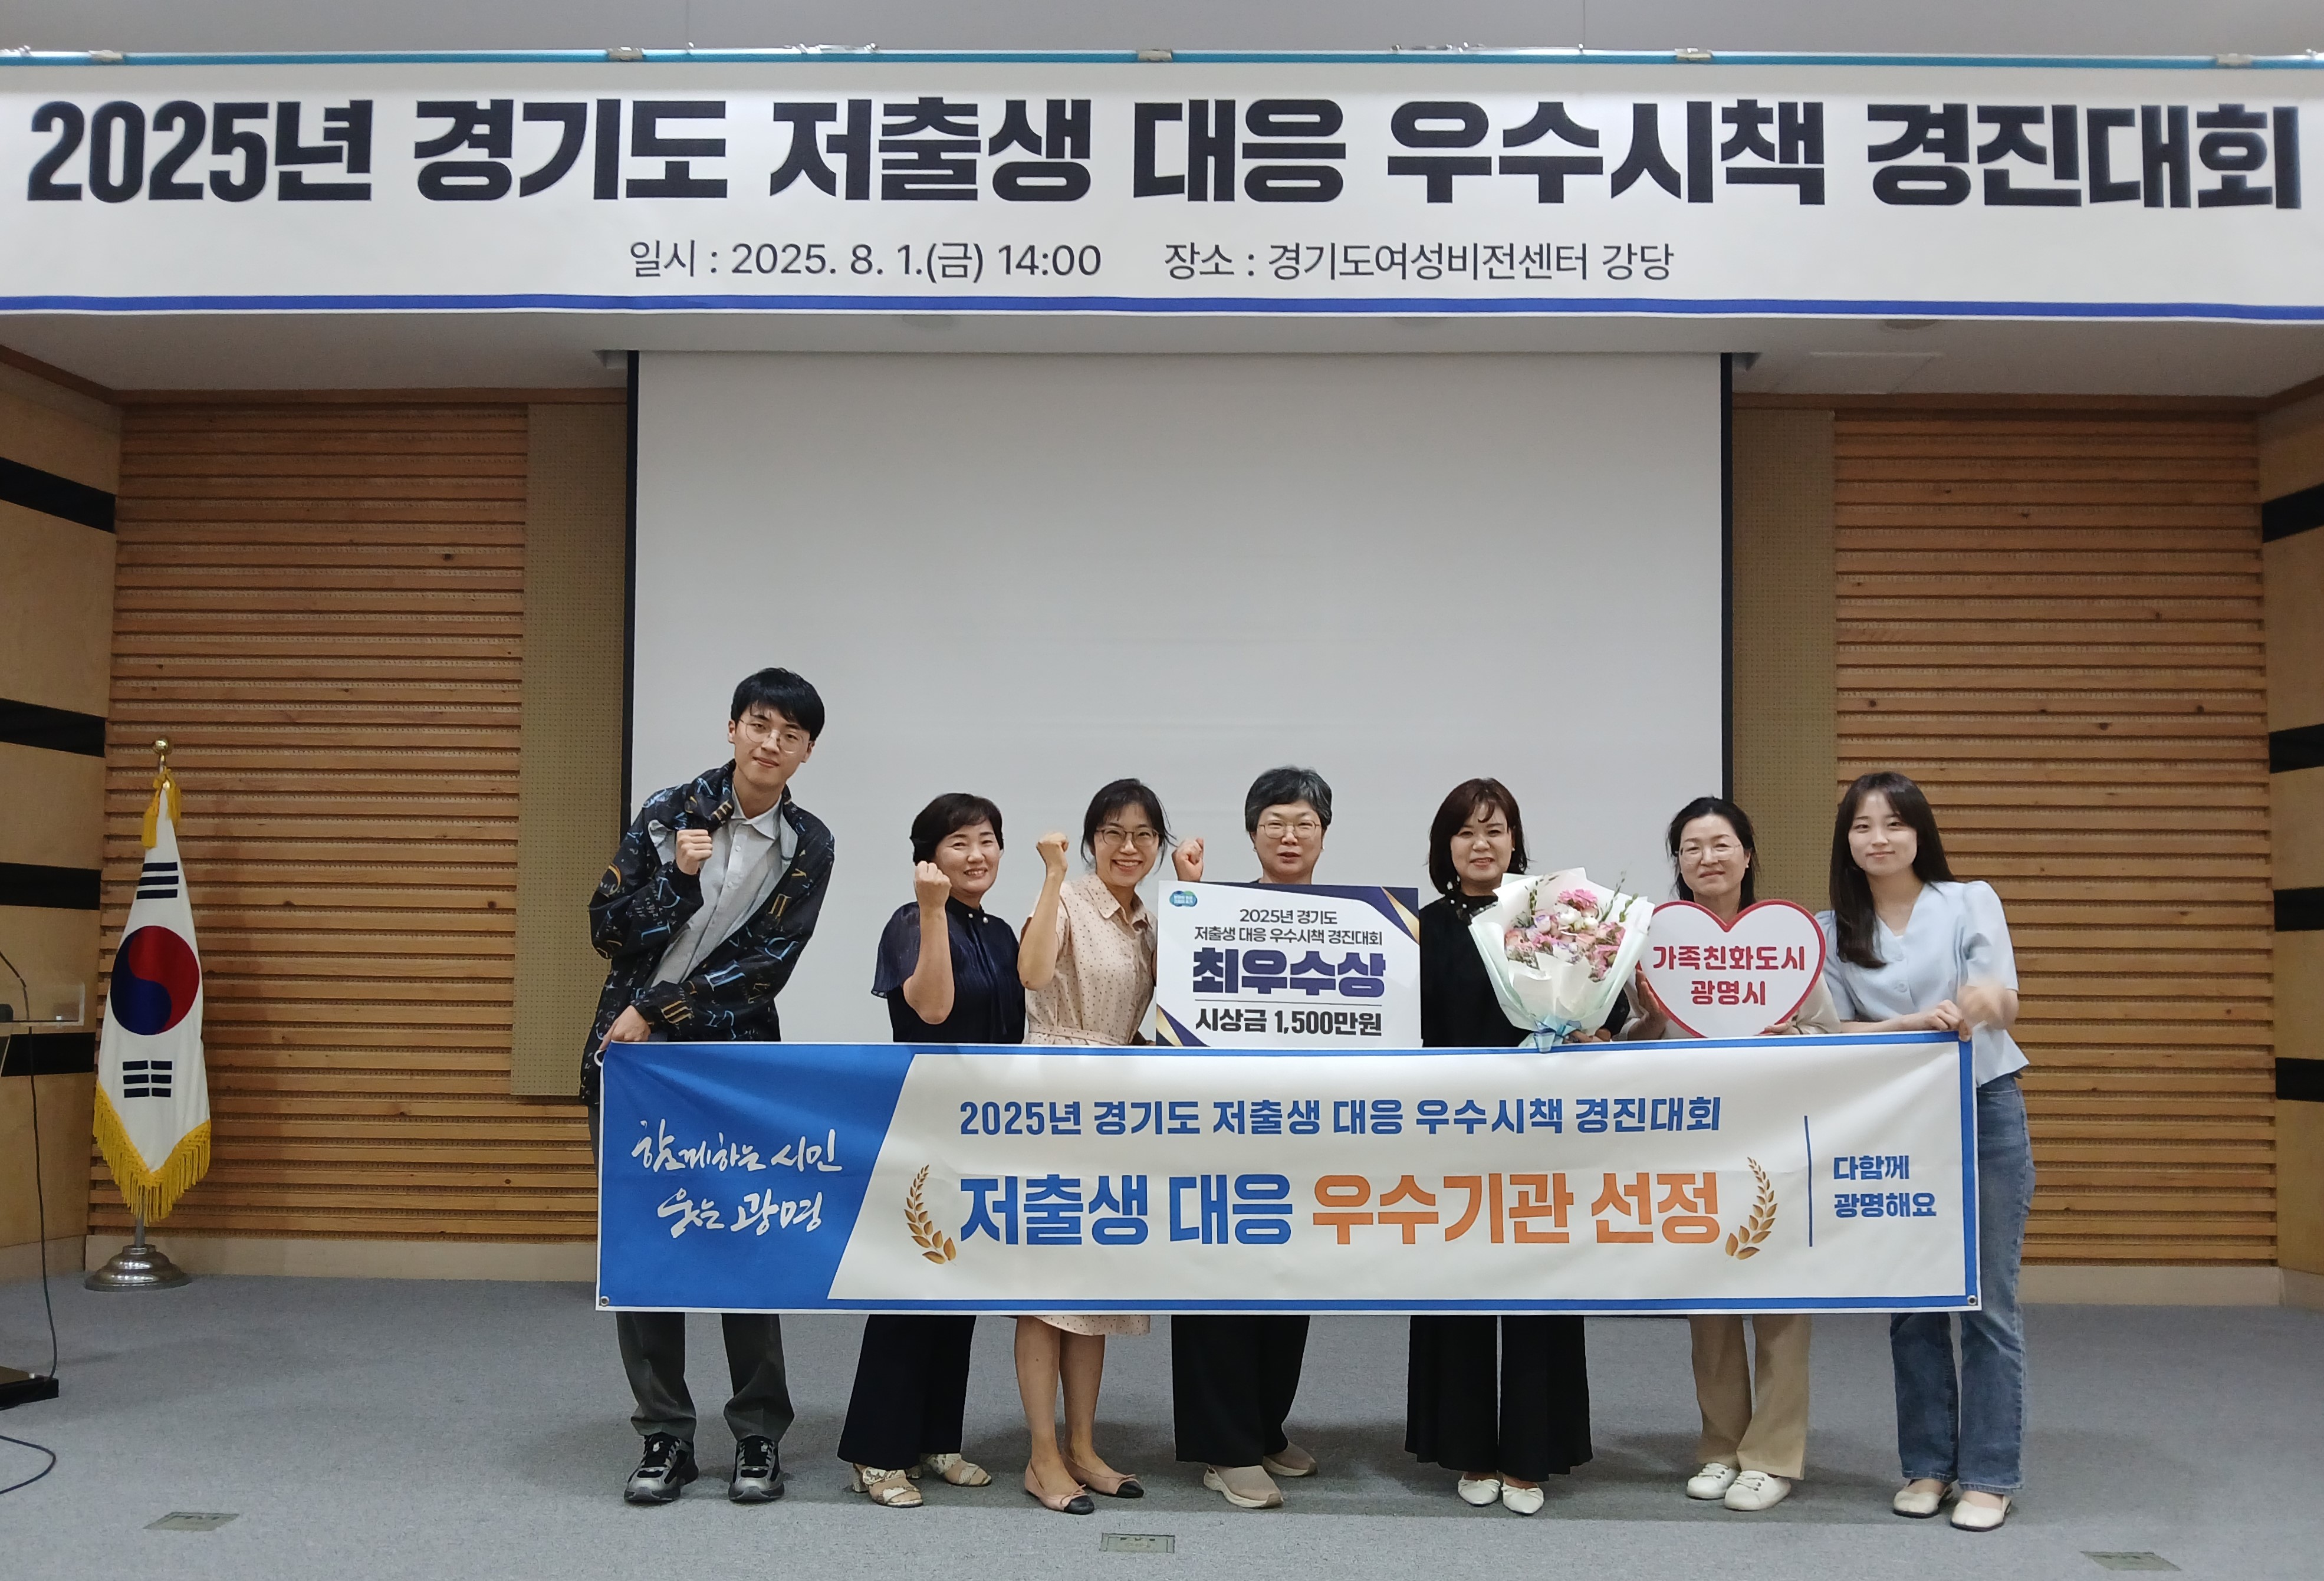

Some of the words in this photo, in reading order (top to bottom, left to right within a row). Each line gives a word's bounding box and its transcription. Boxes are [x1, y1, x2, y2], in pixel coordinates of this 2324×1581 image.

[27, 99, 373, 203] 2025년
[413, 98, 728, 202] 경기도
[770, 97, 1092, 202] 저출생
[1133, 98, 1346, 203] 대응
[1387, 98, 1825, 205] 우수시책
[1867, 103, 2302, 209] 경진대회
[630, 239, 695, 277] 일시
[731, 243, 837, 275] 2025.
[850, 244, 883, 275] 8.
[898, 242, 984, 284] 1.(금)
[998, 245, 1102, 276] 14:00
[1165, 242, 1234, 280] 장소
[1268, 242, 1587, 281] 경기도여성비전센터
[1602, 243, 1675, 281] 강당
[1194, 926, 1236, 941] 저출생
[1238, 927, 1267, 943] 대응
[1269, 928, 1324, 945] 우수시책
[1327, 929, 1382, 946] 경진대회
[1239, 908, 1294, 925] 2025년
[1296, 909, 1338, 925] 경기도
[1192, 947, 1386, 998] 최우수상
[1652, 945, 1805, 971] 가족친화도시
[1691, 980, 1766, 1005] 광명시
[1195, 1008, 1267, 1033] 시상금
[1274, 1010, 1382, 1037] 1,500만원
[960, 1101, 1082, 1136] 2025년
[1093, 1100, 1200, 1135] 경기도
[1213, 1099, 1320, 1135] 저출생
[1333, 1099, 1403, 1135] 대응
[1416, 1097, 1563, 1135] 우수시책
[1576, 1096, 1721, 1133] 경진대회
[630, 1118, 767, 1173] 함께하는
[770, 1128, 843, 1172] 시민
[1833, 1155, 1910, 1181] 다함께
[656, 1187, 725, 1239] 웃는
[729, 1188, 824, 1237] 광명
[960, 1174, 1149, 1245] 저출생
[1169, 1174, 1293, 1245] 대응
[1313, 1173, 1574, 1245] 우수기관
[1591, 1172, 1721, 1244] 선정
[1834, 1192, 1937, 1218] 광명해요
